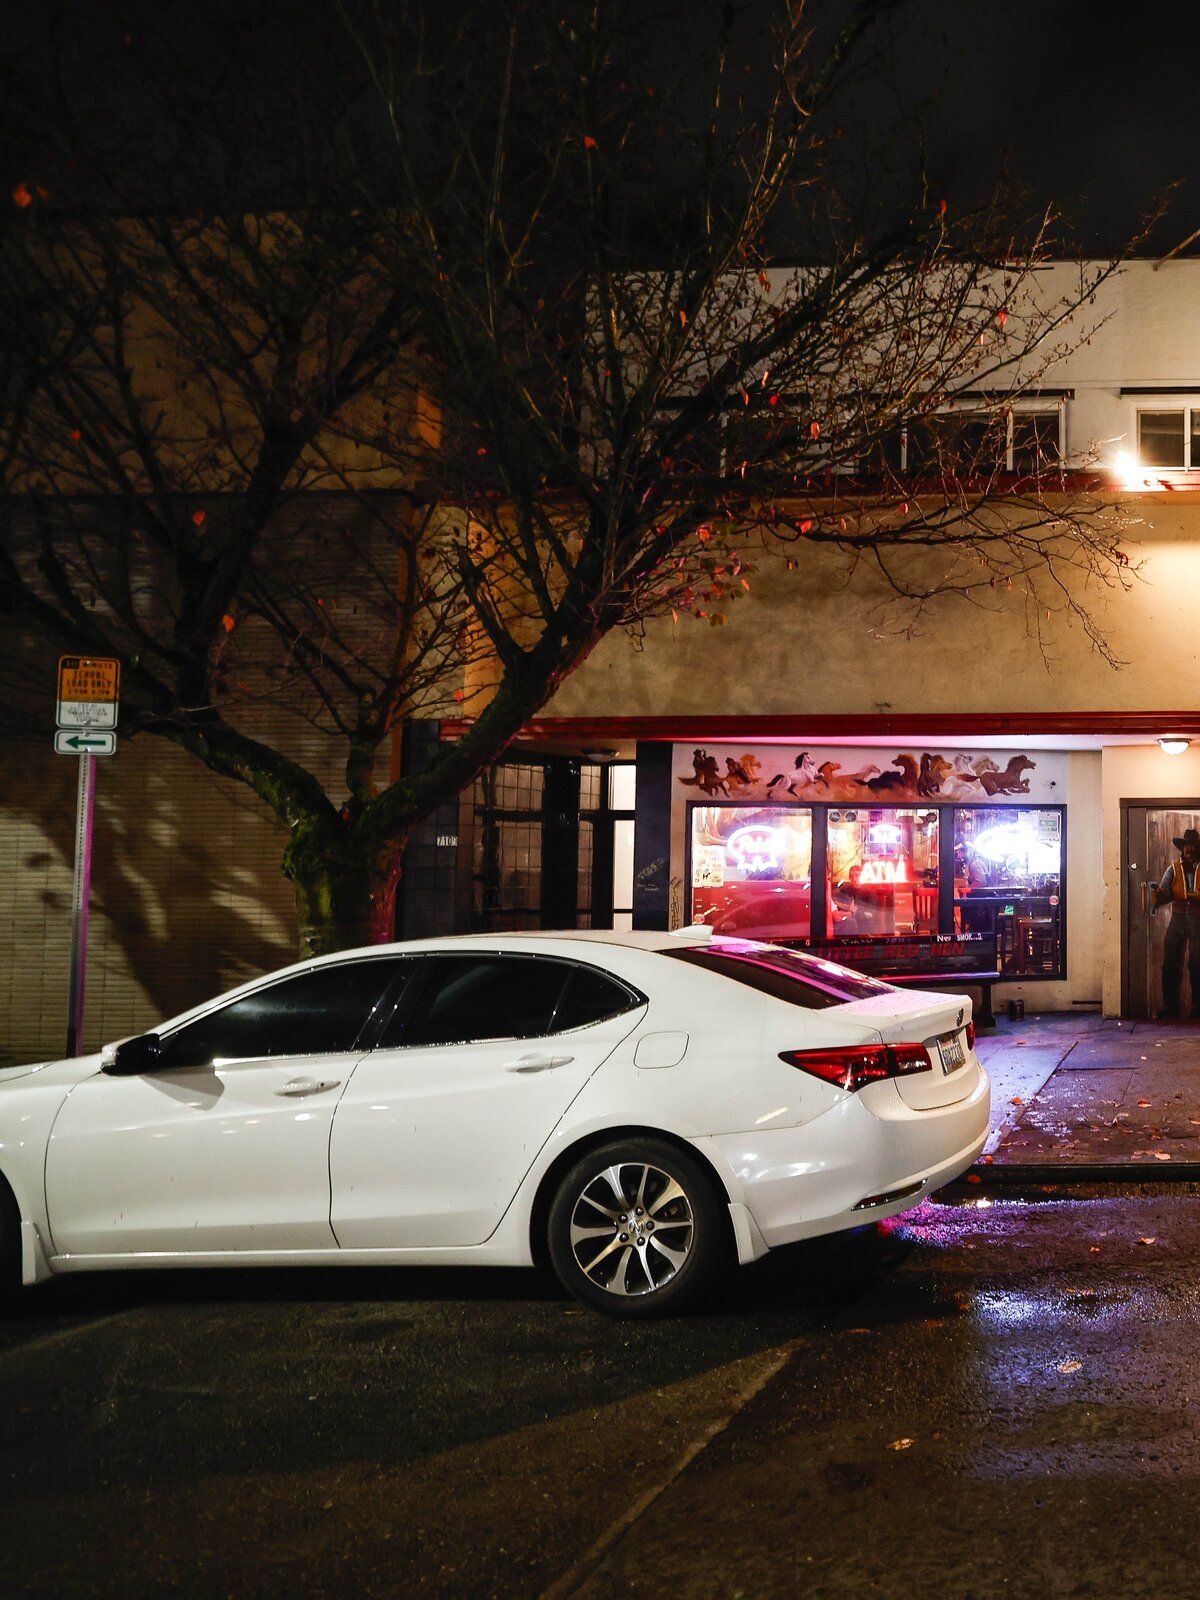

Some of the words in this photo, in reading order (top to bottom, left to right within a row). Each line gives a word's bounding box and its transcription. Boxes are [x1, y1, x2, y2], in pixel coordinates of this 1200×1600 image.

[860, 861, 907, 883] ATM
[885, 943, 920, 958] RED
[930, 942, 966, 956] HEN
